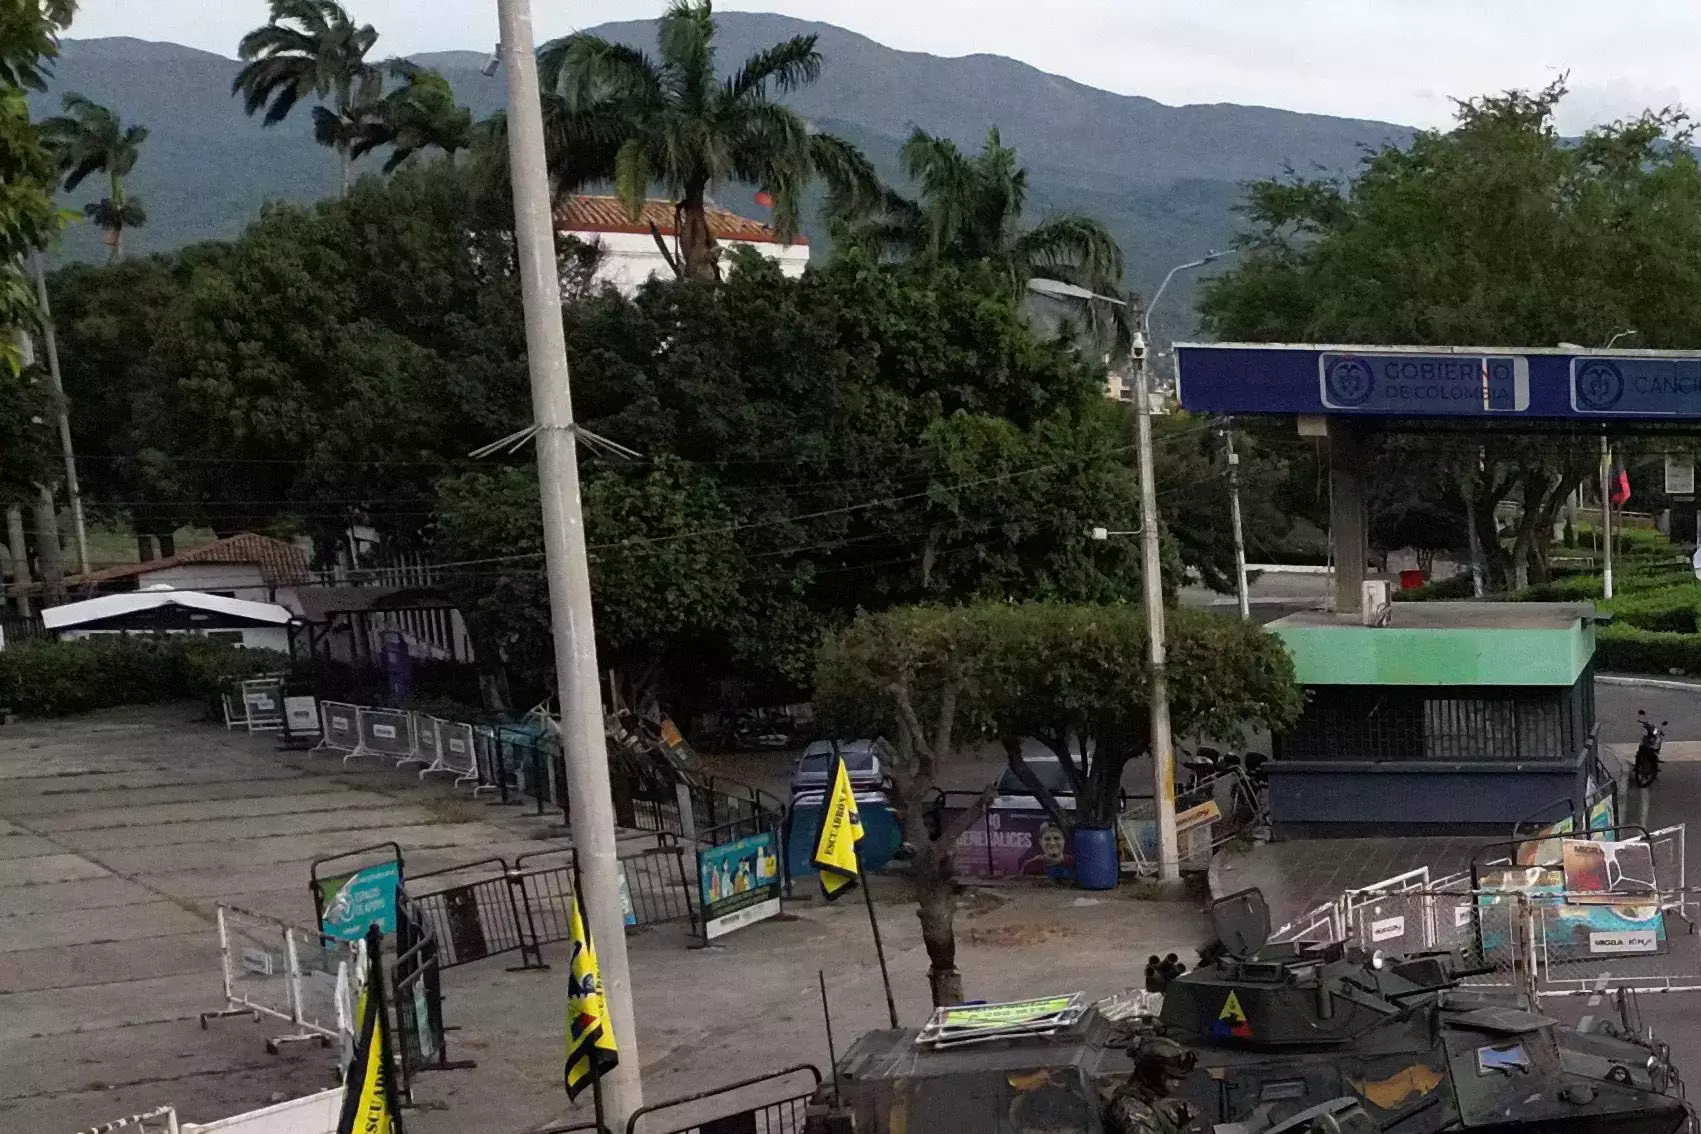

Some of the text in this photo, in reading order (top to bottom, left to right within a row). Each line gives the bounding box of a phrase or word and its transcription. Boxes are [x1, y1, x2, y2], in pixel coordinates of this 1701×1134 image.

[1384, 362, 1510, 381] GOBIERNO
[1385, 385, 1509, 400] DE COLOMBIA
